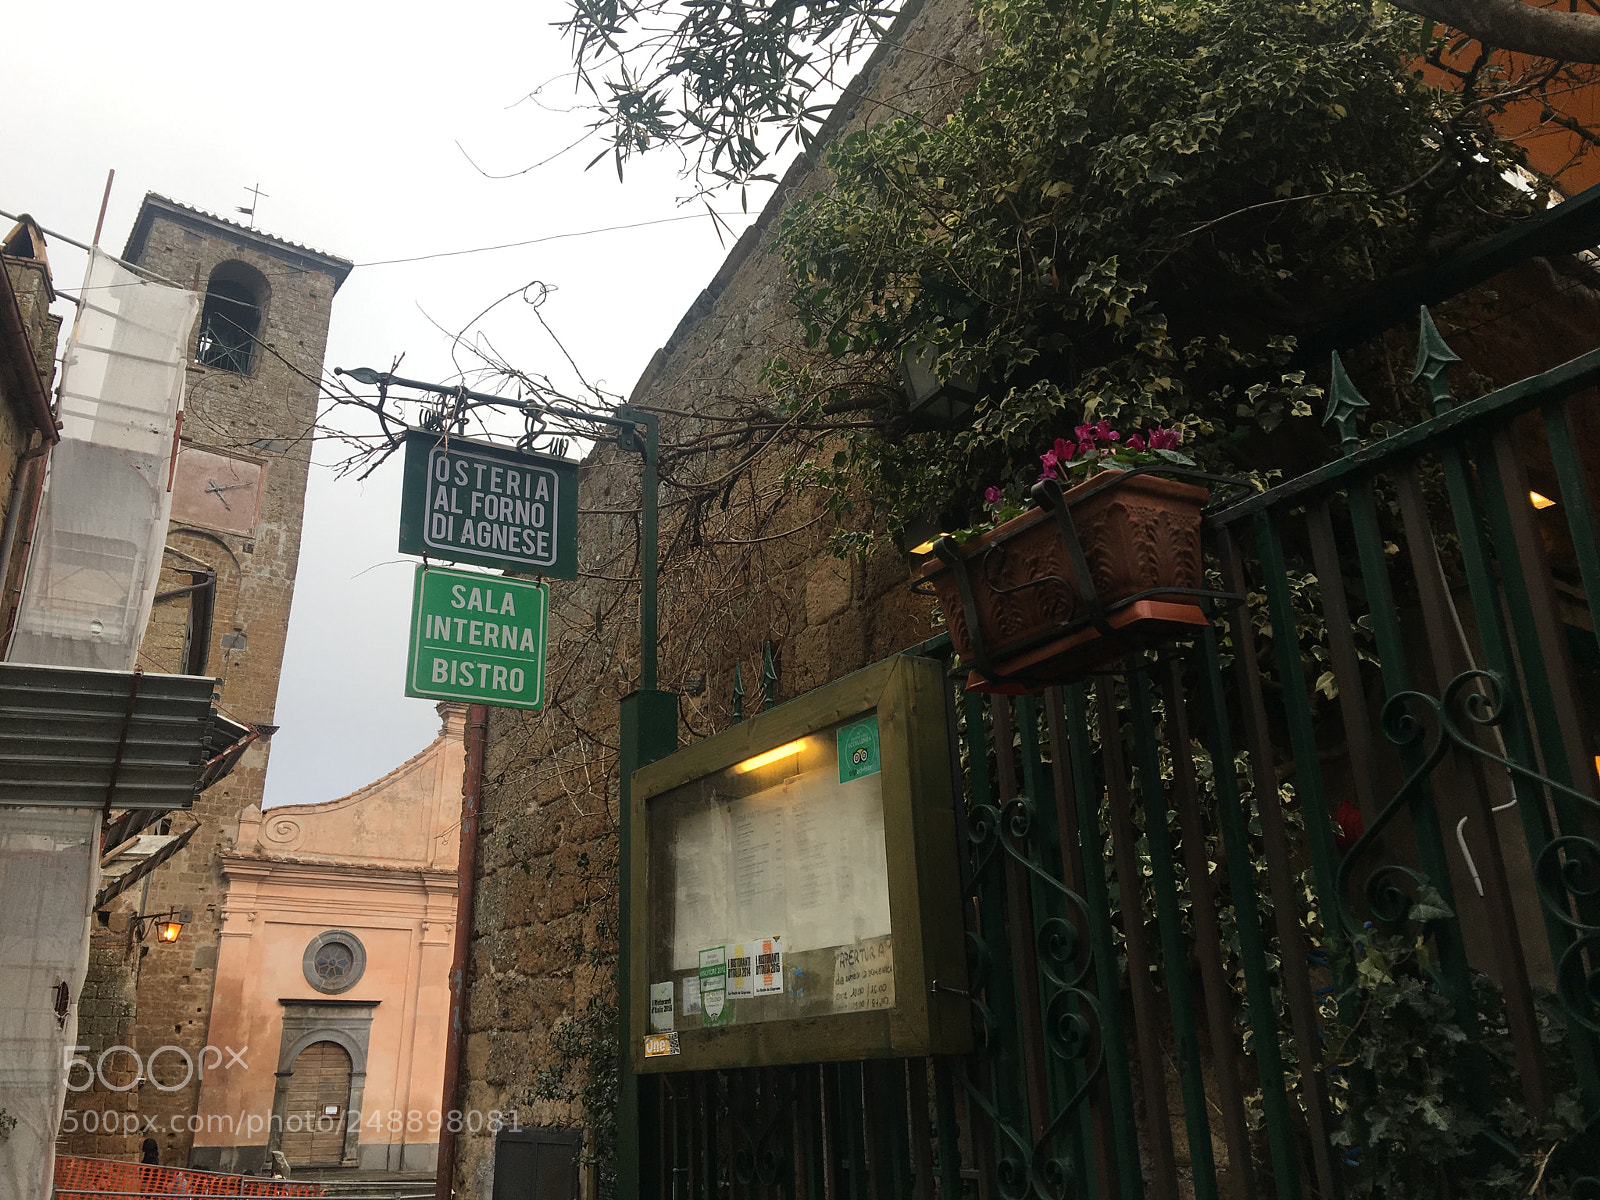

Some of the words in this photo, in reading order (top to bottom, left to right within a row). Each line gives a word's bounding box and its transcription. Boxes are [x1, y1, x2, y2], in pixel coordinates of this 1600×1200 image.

[435, 456, 549, 502] OSTERIA
[434, 485, 463, 514] AL
[471, 491, 545, 528] FORNO
[431, 512, 454, 541] DI
[461, 519, 550, 558] AGNESE
[451, 584, 516, 617] SALA
[425, 614, 535, 653] INTERNA
[431, 658, 525, 693] BISTRO
